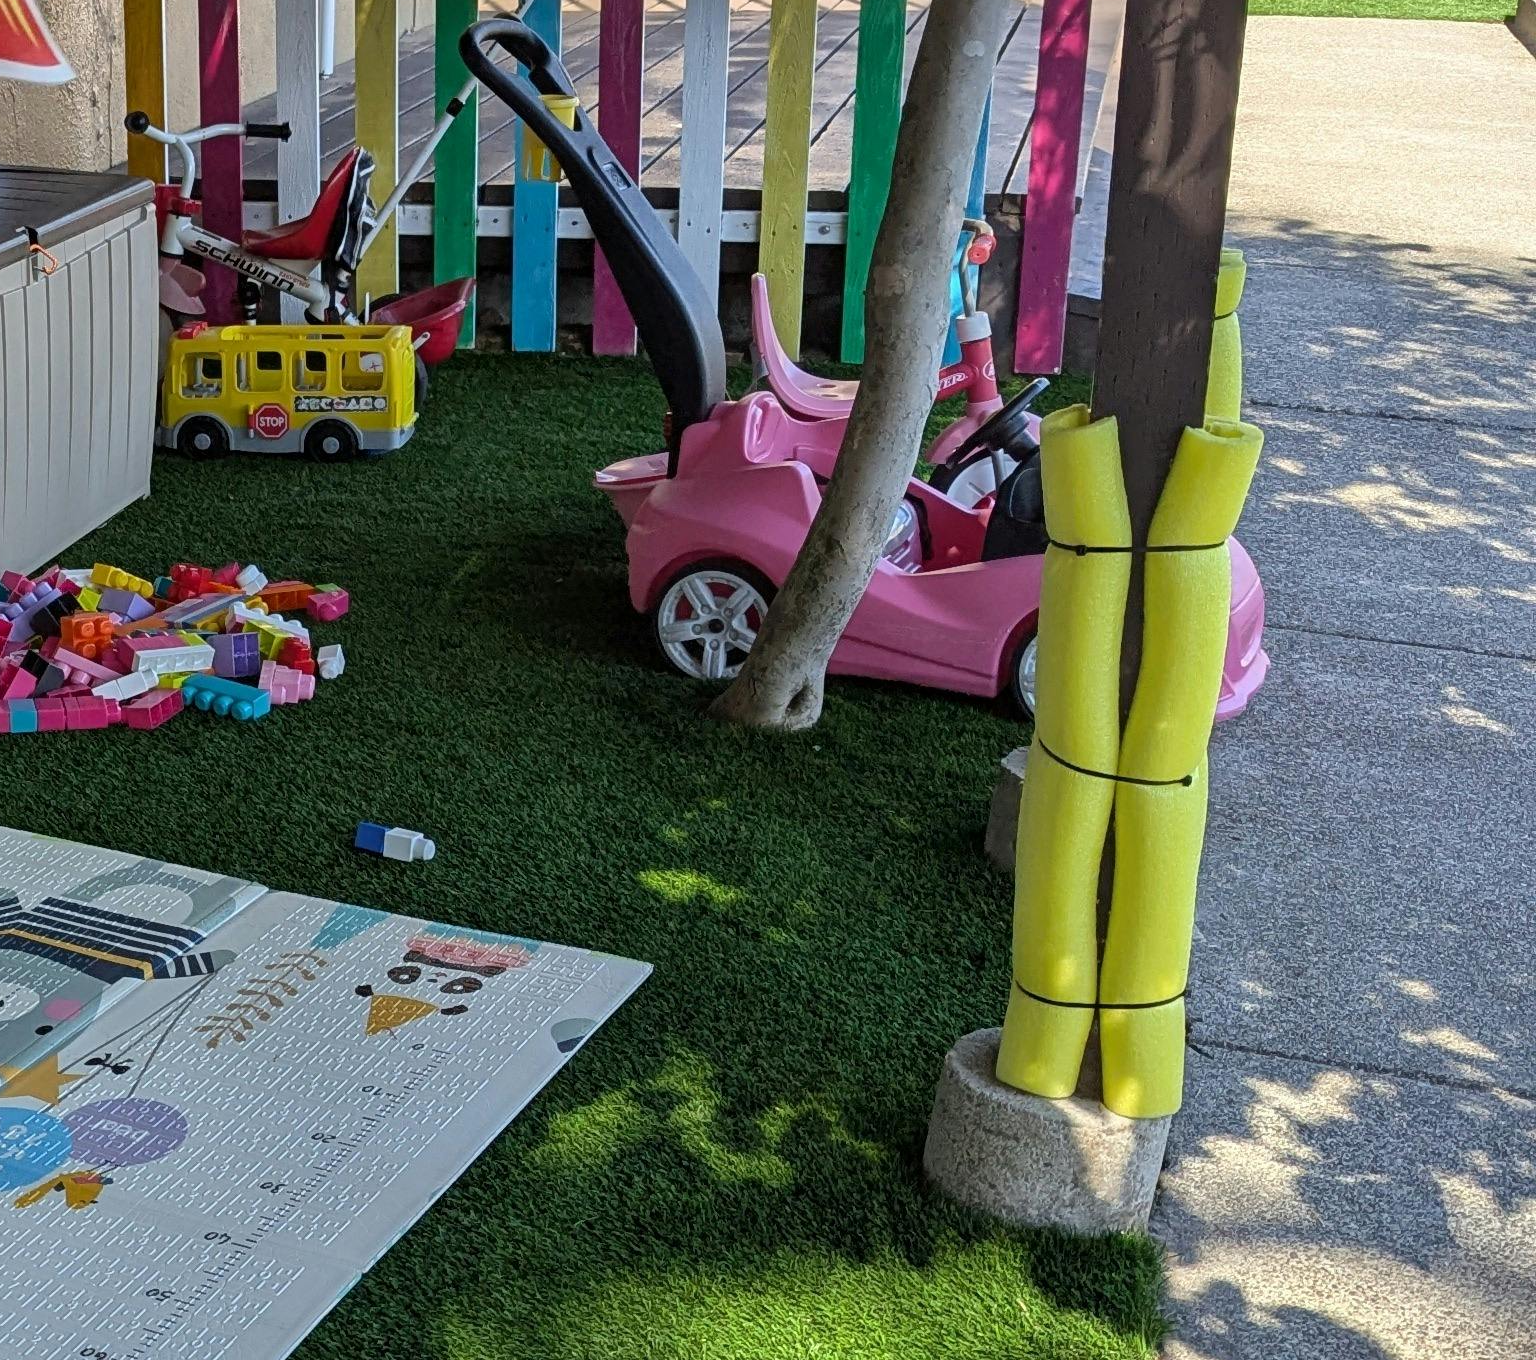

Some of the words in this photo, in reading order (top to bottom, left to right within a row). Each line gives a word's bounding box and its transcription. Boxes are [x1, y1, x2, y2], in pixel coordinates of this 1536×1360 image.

[192, 240, 294, 292] SCHWINN
[260, 416, 284, 427] STOP
[362, 1085, 383, 1095] 10
[94, 1119, 151, 1141] bear
[310, 1132, 337, 1143] 20
[259, 1181, 287, 1194] 30
[204, 1231, 232, 1245] 40
[145, 1288, 176, 1301] 50
